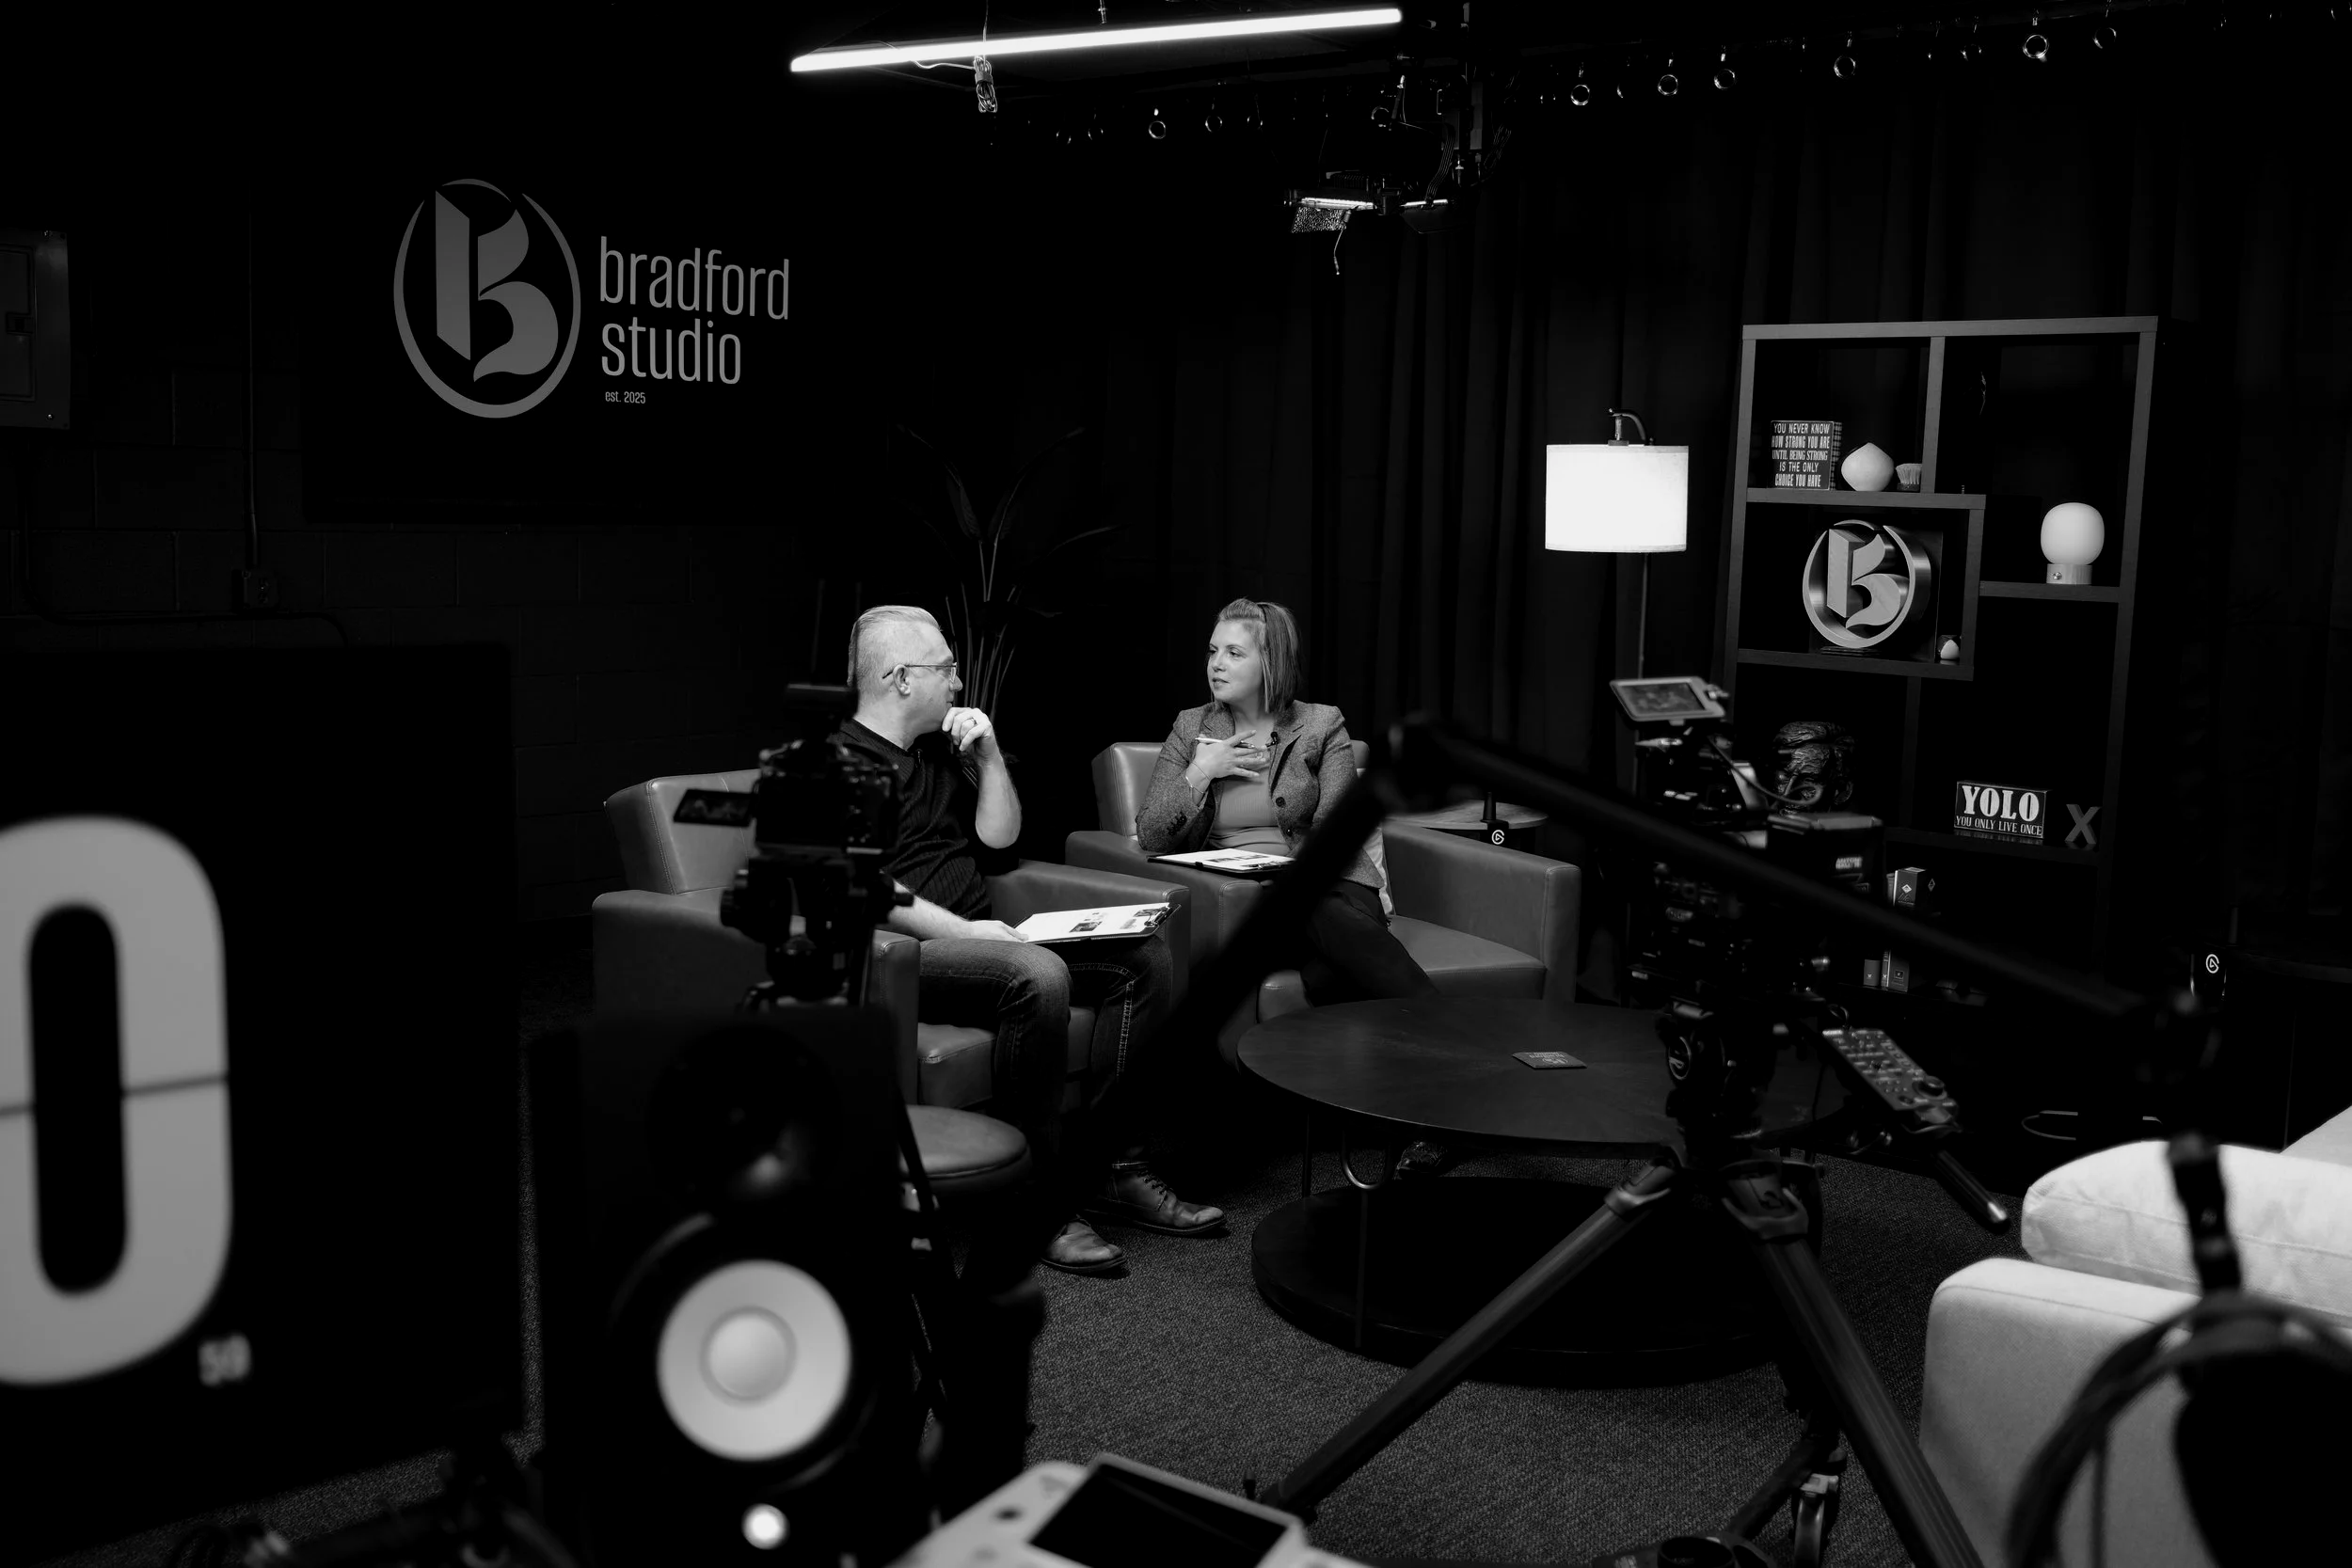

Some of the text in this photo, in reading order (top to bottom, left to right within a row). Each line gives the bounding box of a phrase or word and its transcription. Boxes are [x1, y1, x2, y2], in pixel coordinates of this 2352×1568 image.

[600, 235, 788, 320] bradford
[601, 316, 741, 385] studio
[605, 390, 646, 404] est. 2025
[1773, 422, 1831, 435] YOU NEVER KNOW
[1771, 436, 1831, 449] HOW STRONG YOU ARE
[1772, 450, 1828, 461] UNTIL BEING STRONG
[1779, 461, 1820, 473] IS THE ONLY
[1774, 473, 1821, 487] CHOICE YOU HAVE
[1962, 784, 2040, 822] YOLO
[1956, 815, 2042, 836] YOU ONLY LIVE ONCE
